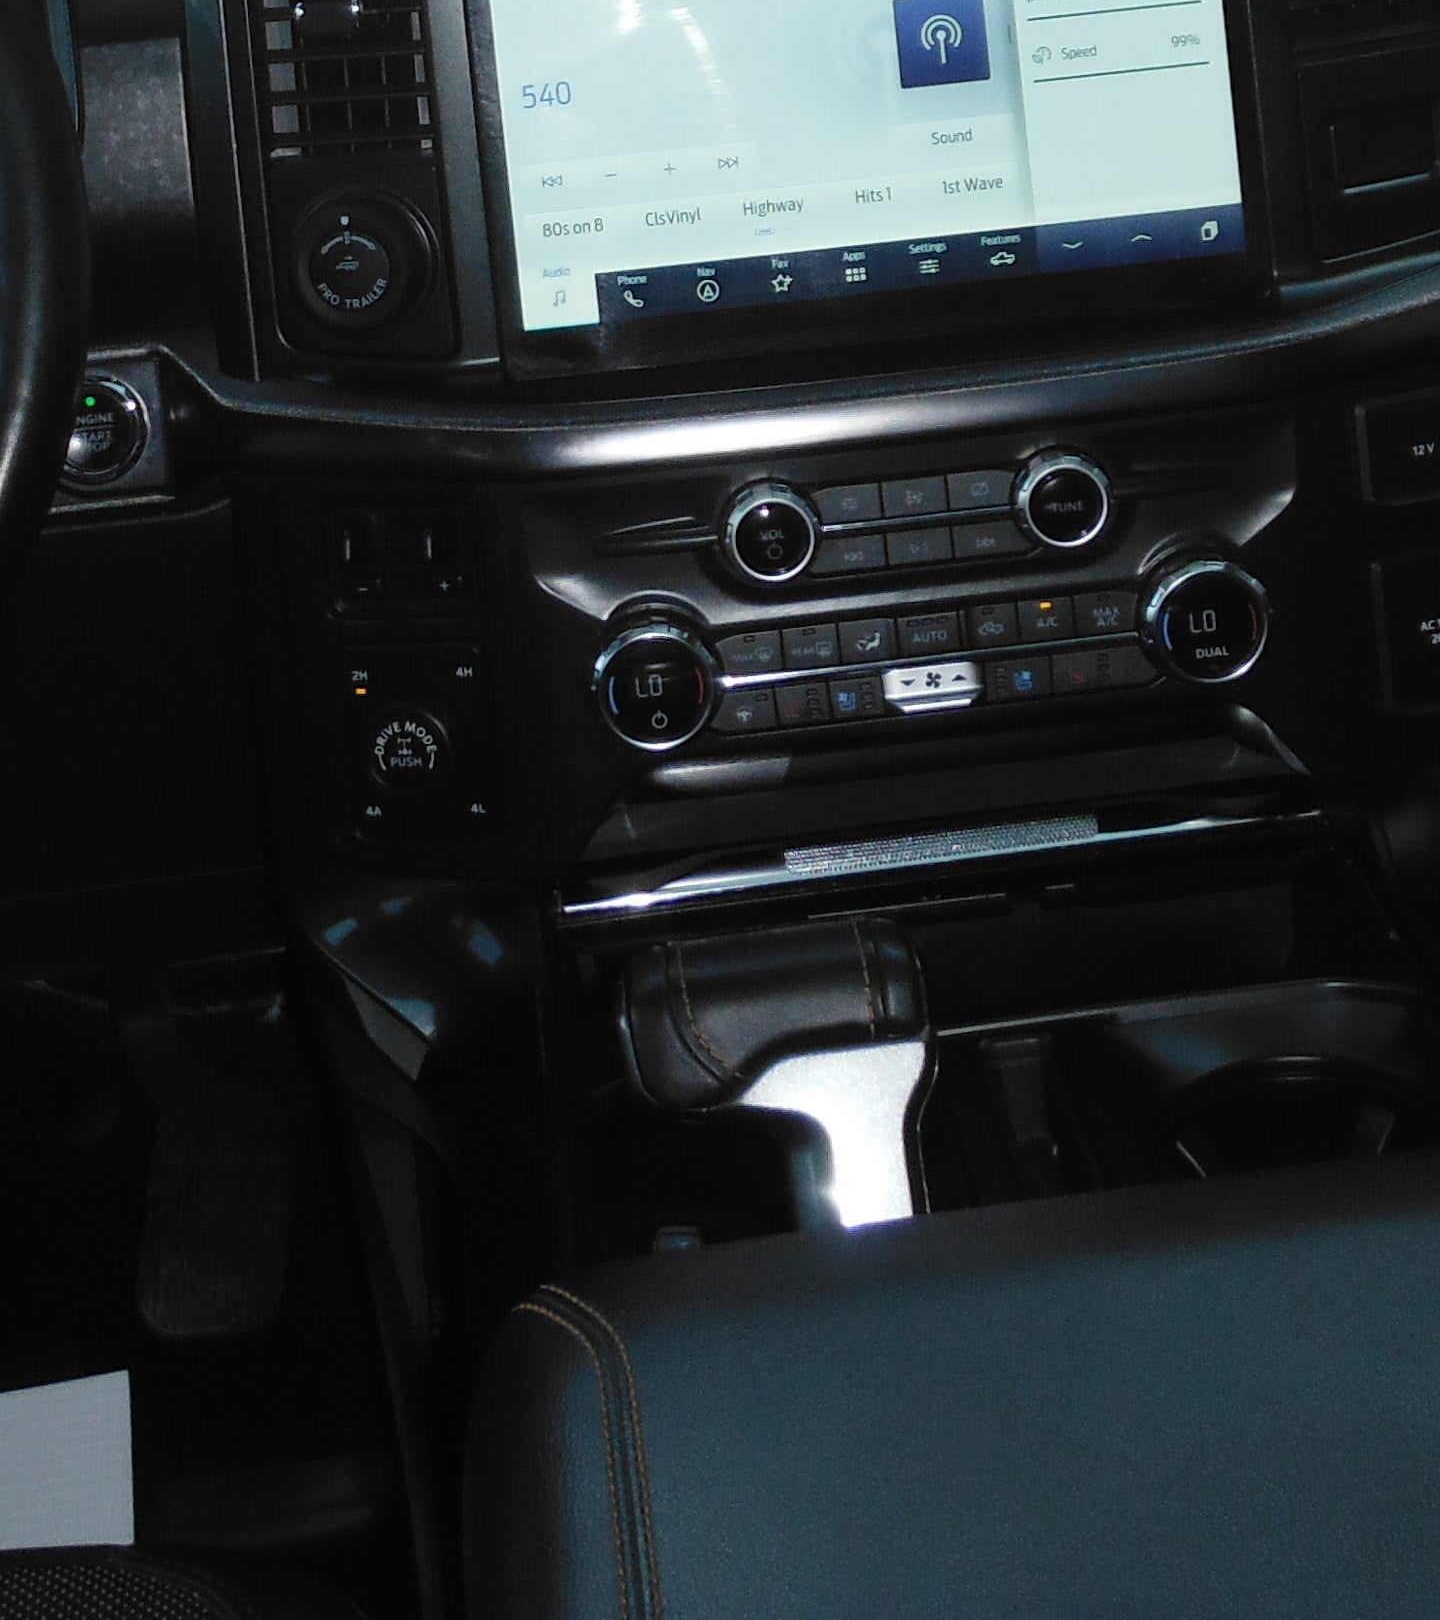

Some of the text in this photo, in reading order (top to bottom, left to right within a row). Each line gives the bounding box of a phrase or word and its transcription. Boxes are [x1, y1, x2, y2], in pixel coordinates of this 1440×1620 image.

[1171, 34, 1202, 48] 99%
[1060, 45, 1098, 62] Speed
[521, 80, 572, 109] 540
[931, 128, 973, 146] Sound
[942, 175, 1004, 195] 1st Wave
[855, 186, 893, 205] Hits 1
[742, 198, 805, 218] Highway
[645, 206, 703, 227] ClsVinyl
[542, 218, 604, 238] 80s on 8
[980, 233, 1022, 247] Features
[908, 241, 948, 255] Settings
[771, 258, 790, 269] Fav
[842, 250, 867, 263] Apps
[542, 266, 571, 279] Audio
[696, 266, 716, 277] Nav
[616, 273, 648, 287] Phone
[317, 277, 388, 310] PRO TRAILER
[1412, 442, 1436, 457] 12 V
[1051, 499, 1085, 514] TUNE
[1036, 616, 1059, 628] A/C
[1420, 619, 1436, 632] AC
[912, 630, 949, 644] AUTO
[1195, 644, 1231, 660] DUAL
[351, 669, 370, 682] 2H
[455, 665, 474, 678] 4H
[374, 720, 438, 756] DRIVE MODE
[390, 756, 423, 768] PUSH
[365, 804, 384, 818] 4A
[470, 800, 488, 814] 4L
